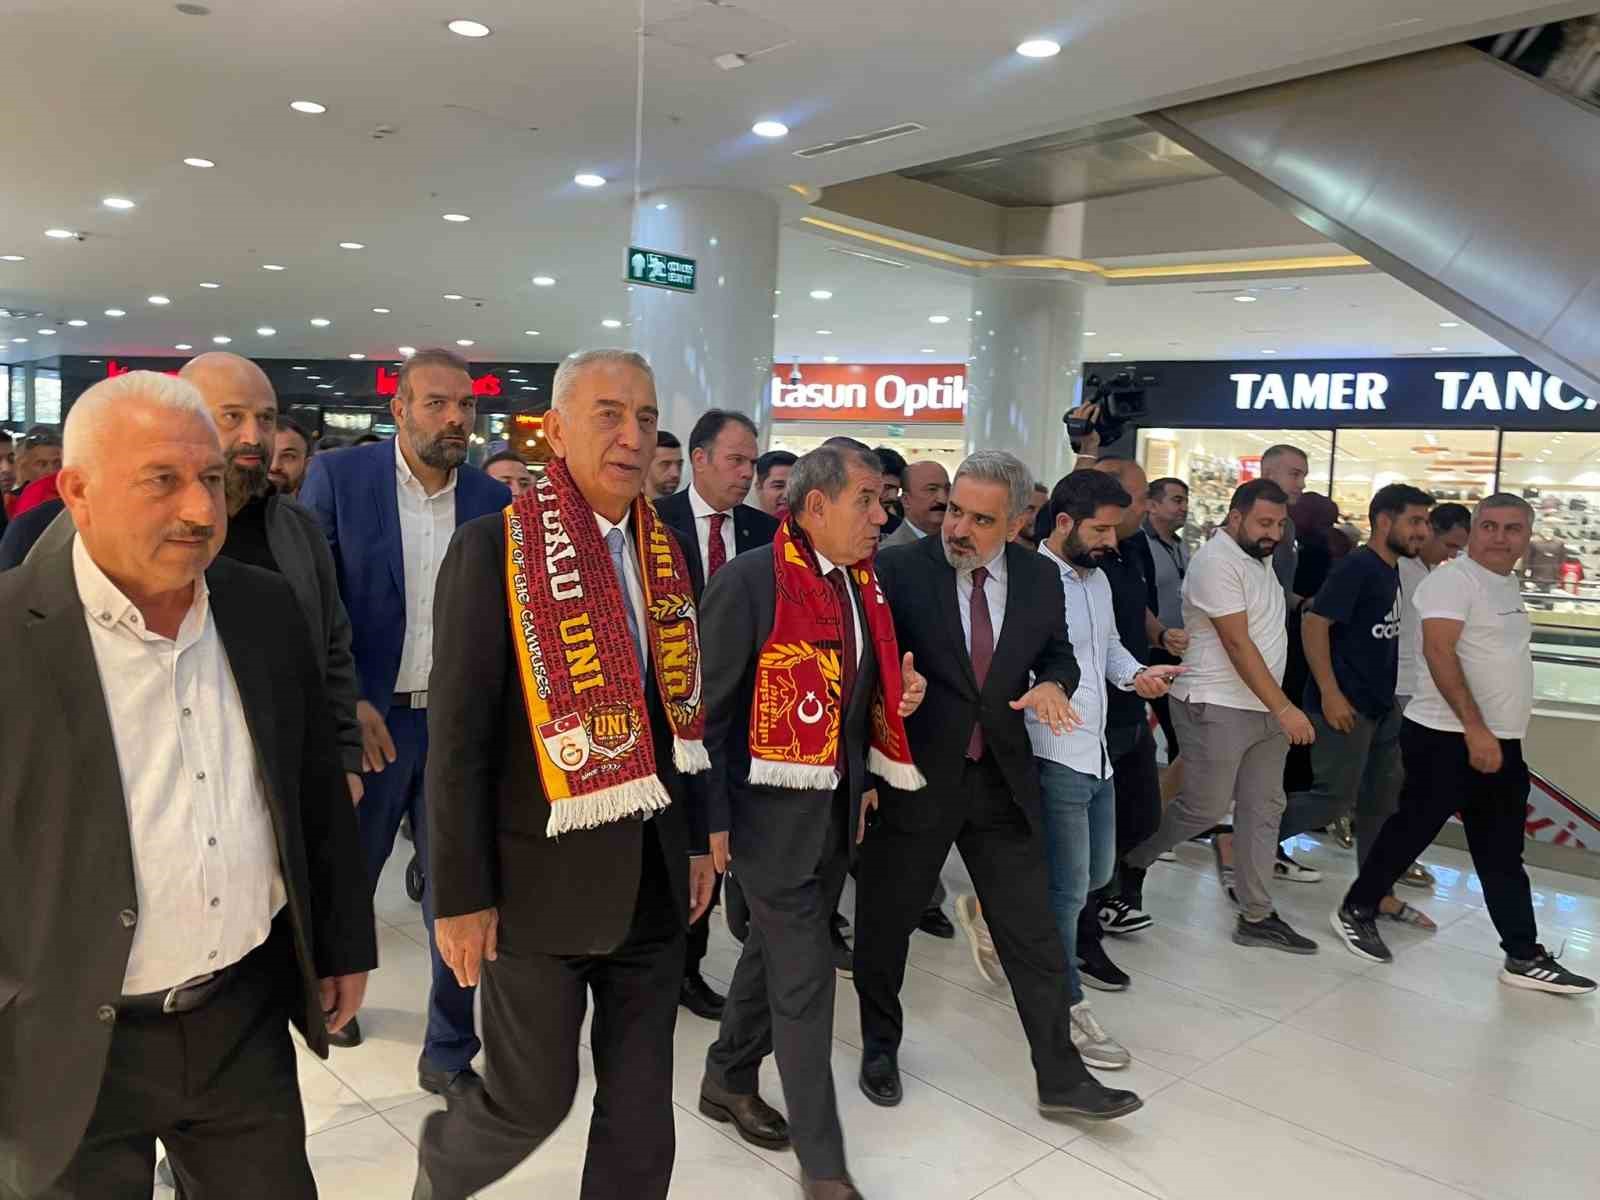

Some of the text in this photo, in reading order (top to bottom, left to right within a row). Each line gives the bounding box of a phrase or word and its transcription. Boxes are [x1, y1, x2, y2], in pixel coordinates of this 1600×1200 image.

[1229, 372, 1389, 410] TAMER
[513, 549, 526, 569] OF
[521, 609, 551, 699] CAMPUSES
[559, 612, 604, 694] UNI
[660, 622, 688, 697] UNI
[594, 713, 629, 736] UNI
